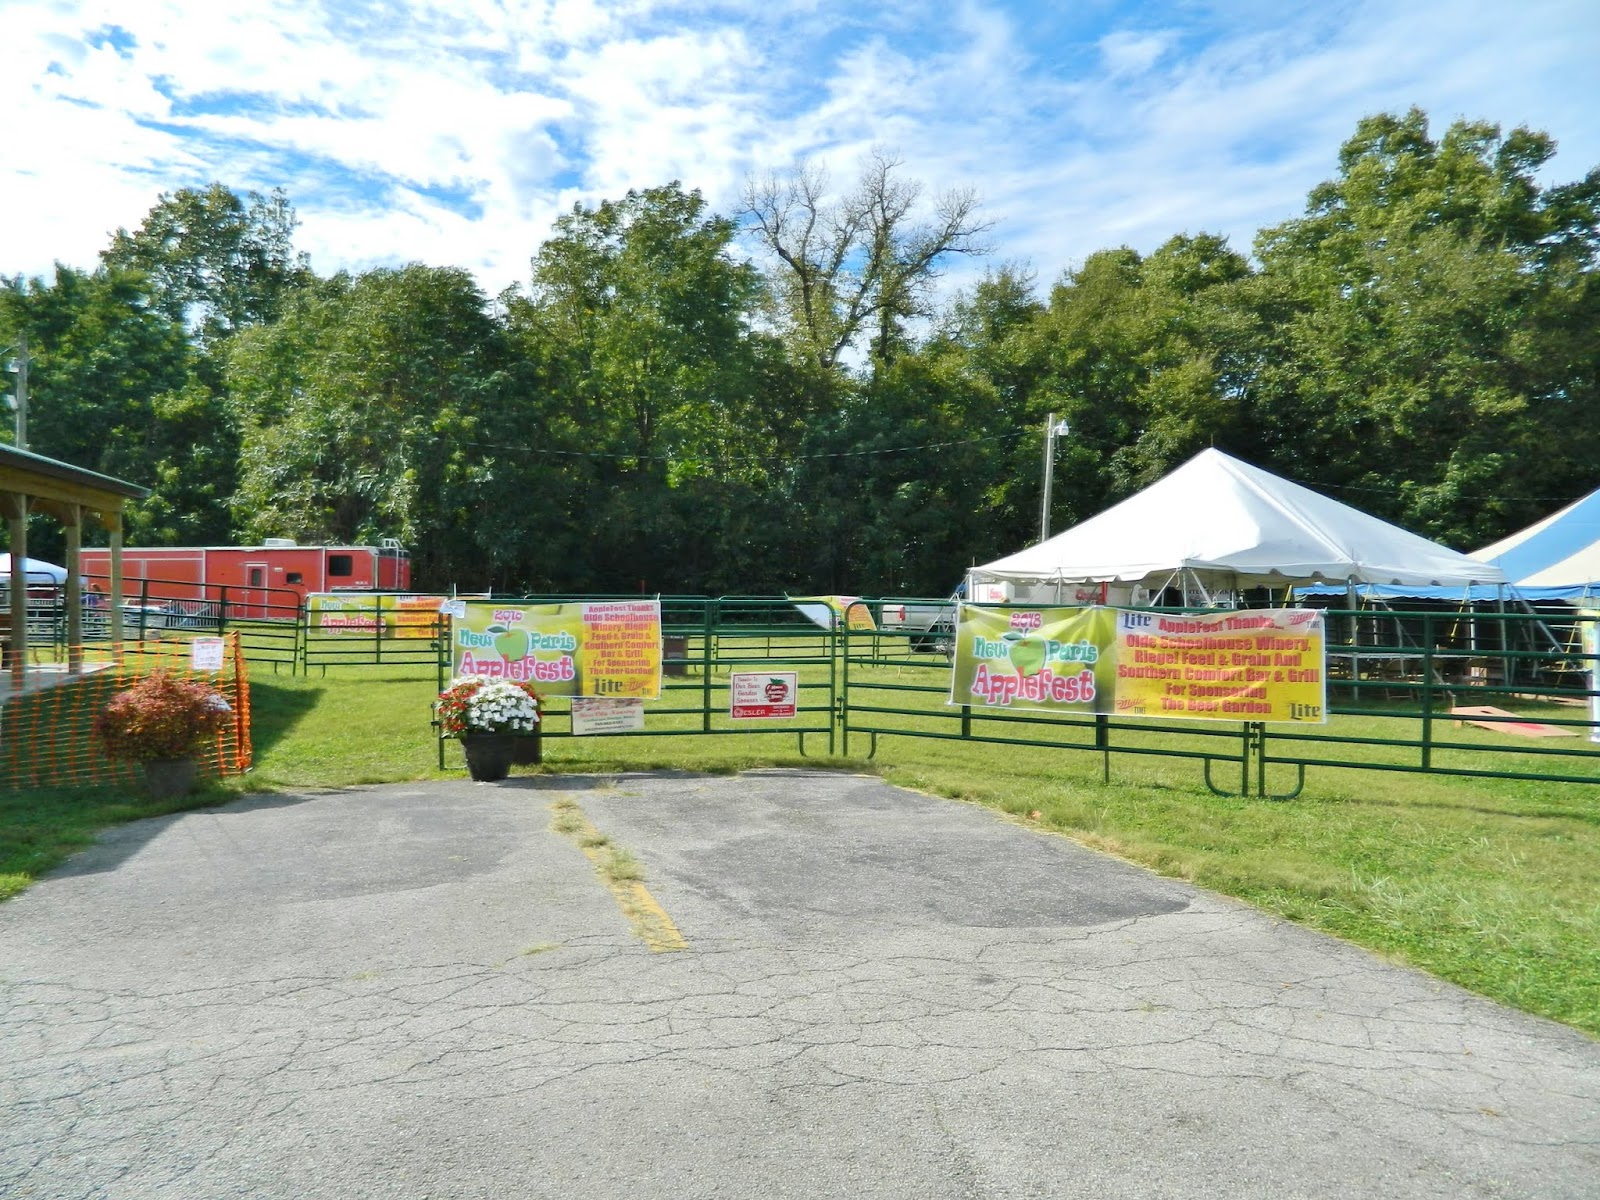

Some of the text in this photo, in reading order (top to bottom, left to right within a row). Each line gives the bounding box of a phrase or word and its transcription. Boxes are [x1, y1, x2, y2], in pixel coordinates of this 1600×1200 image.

[604, 613, 659, 621] Schoolhouse
[1122, 613, 1152, 629] Lite
[1158, 618, 1223, 634] AppleFest
[458, 628, 576, 651] New Paris
[584, 641, 622, 650] Southern
[1126, 634, 1311, 651] Olde Schoolhouse Winery,
[601, 650, 615, 658] Bar
[974, 637, 1098, 662] New Paris
[459, 651, 574, 681] AppleFest
[607, 659, 650, 667] Sponsoring
[1134, 650, 1302, 666] Riegel Feed & Grain And
[625, 667, 654, 675] Garden
[1118, 664, 1320, 682] Southern Comfort Bar & Grill
[594, 678, 623, 696] Lite
[972, 664, 1095, 704] AppleFest
[1165, 682, 1267, 699] For Sponsoring
[1116, 696, 1146, 709] Miller
[1161, 697, 1272, 713] The Beer Garden
[1290, 702, 1320, 720] Lite
